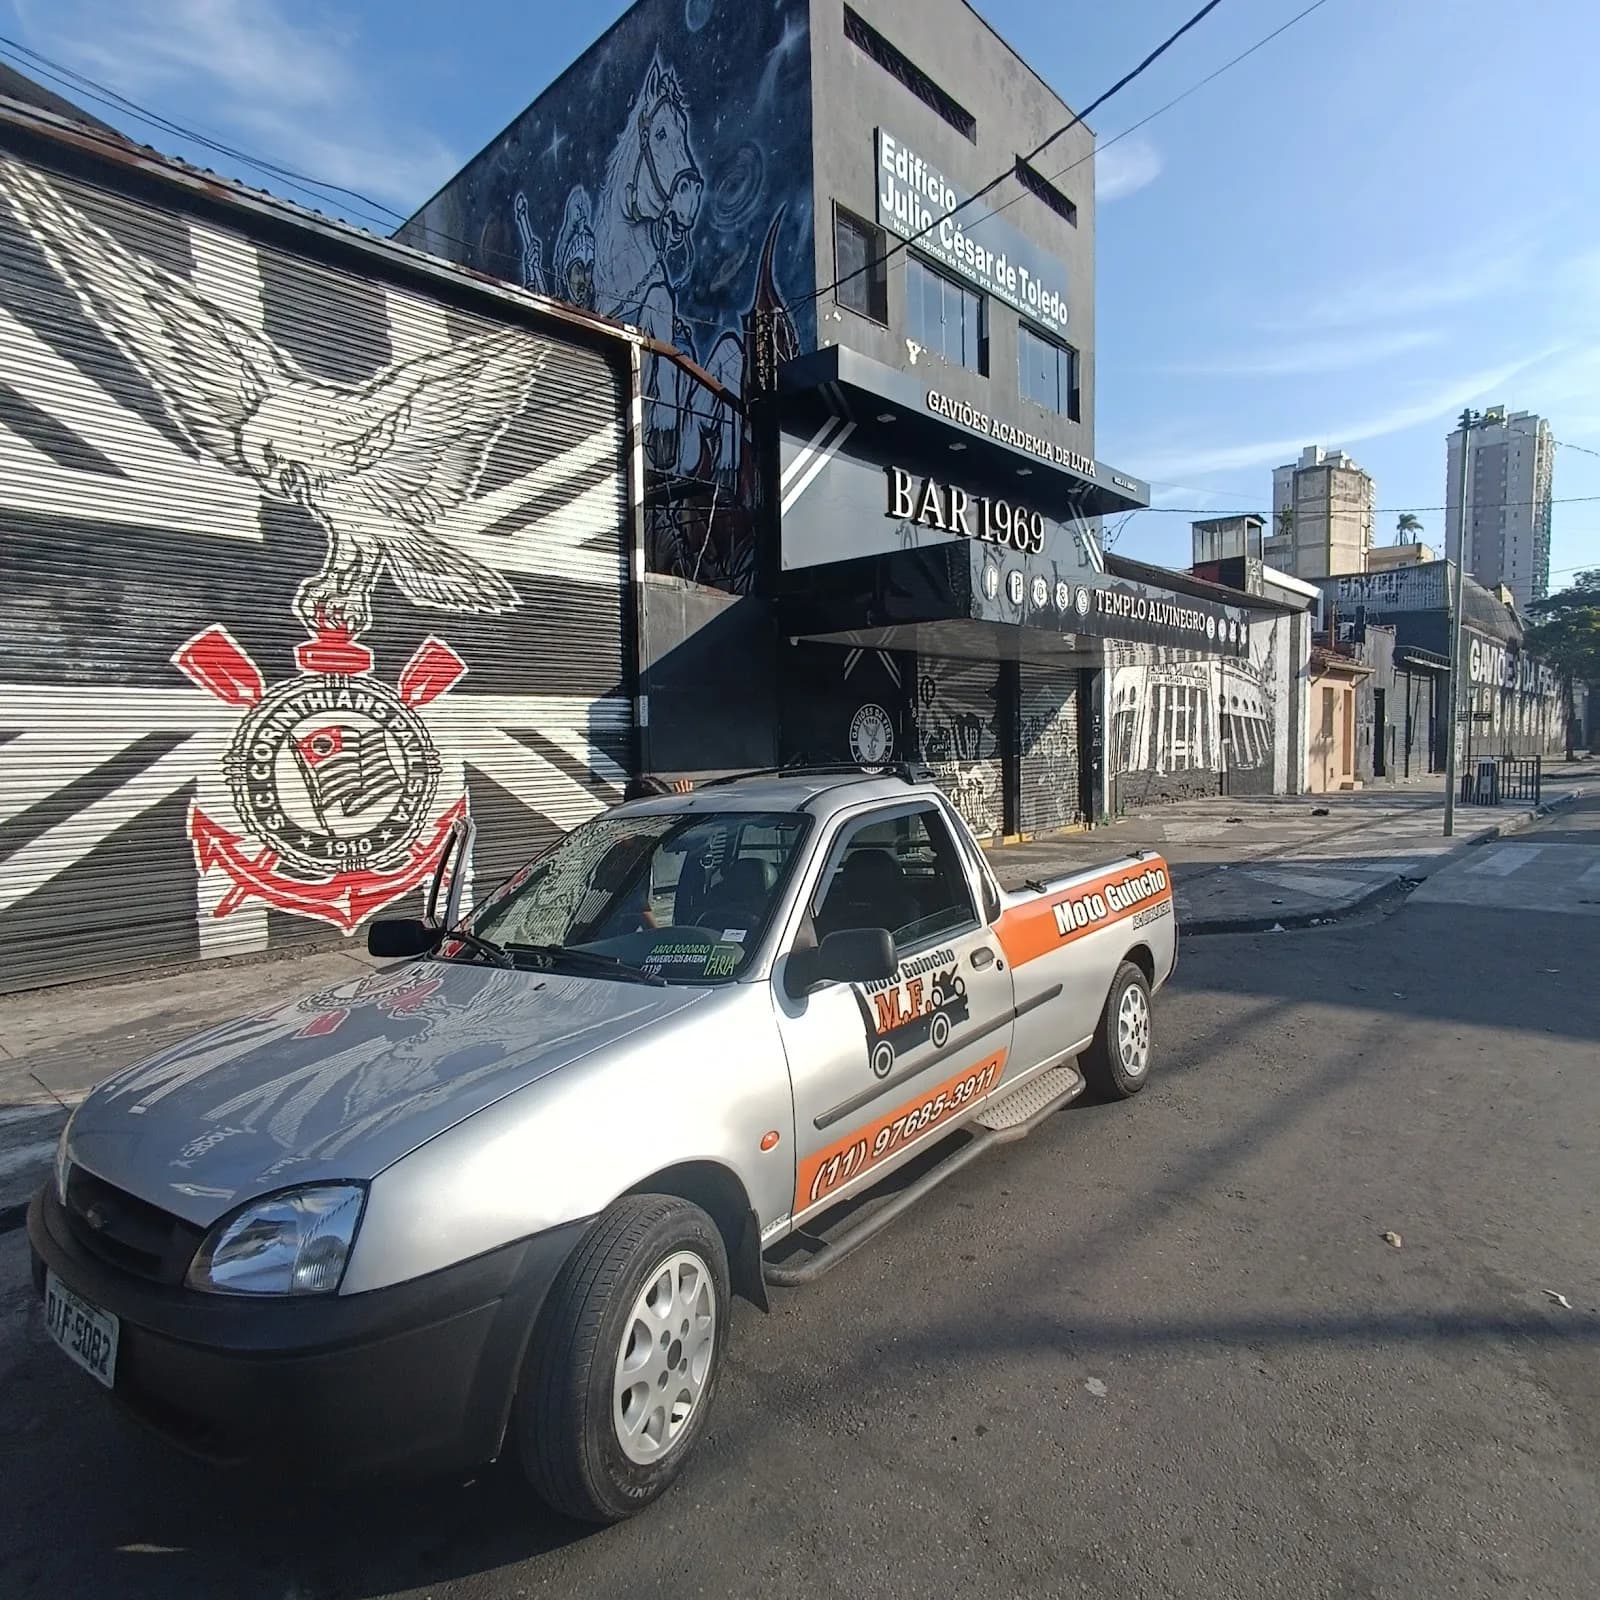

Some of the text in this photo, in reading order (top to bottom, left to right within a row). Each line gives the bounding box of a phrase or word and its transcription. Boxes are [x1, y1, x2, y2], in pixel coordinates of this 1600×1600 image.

[881, 132, 956, 210] Edifício
[881, 175, 1068, 325] Julio César de Toledo
[928, 390, 1097, 478] GAVIÕES ACADEMIA DE LUTA
[889, 466, 1046, 554] BAR 1969
[1095, 588, 1206, 631] TEMPLO ALVINEGRO
[387, 714, 425, 824] PAULISTA
[325, 838, 373, 857] 1910
[1052, 892, 1109, 937] Moto
[1104, 867, 1167, 913] Guincho
[703, 945, 736, 975] FARIA
[901, 949, 955, 979] Guincho
[874, 977, 932, 1035] M.F.
[809, 1060, 998, 1201] (11) 97685-3911
